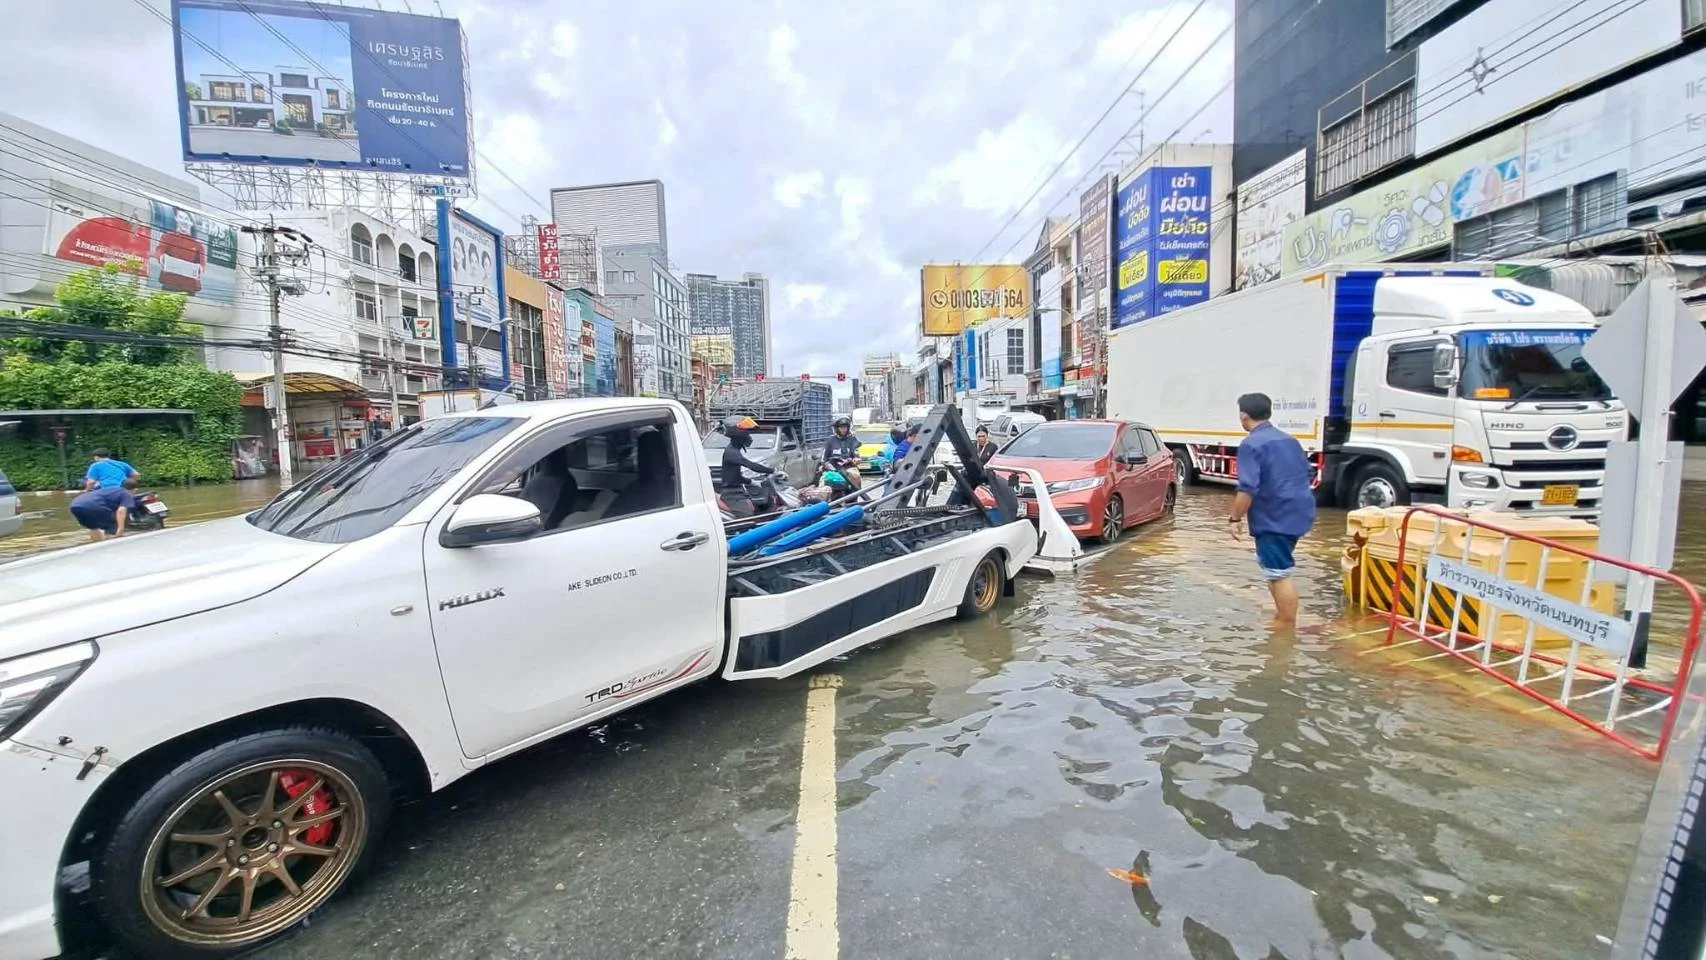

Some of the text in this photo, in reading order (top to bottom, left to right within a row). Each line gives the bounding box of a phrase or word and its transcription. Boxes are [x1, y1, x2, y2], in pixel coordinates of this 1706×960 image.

[381, 88, 439, 103] โครงการใหม่
[402, 118, 412, 126] 20
[1171, 172, 1195, 188] เช่า
[1160, 190, 1206, 213] ผ่อน
[1490, 422, 1525, 430] HINO
[567, 581, 582, 592] AKE
[584, 574, 612, 588] SLIDEON
[439, 586, 506, 611] HILUX
[1439, 562, 1610, 642] ตำรวจภูธรจังหวัดนนทบุรี
[585, 682, 623, 702] TRD
